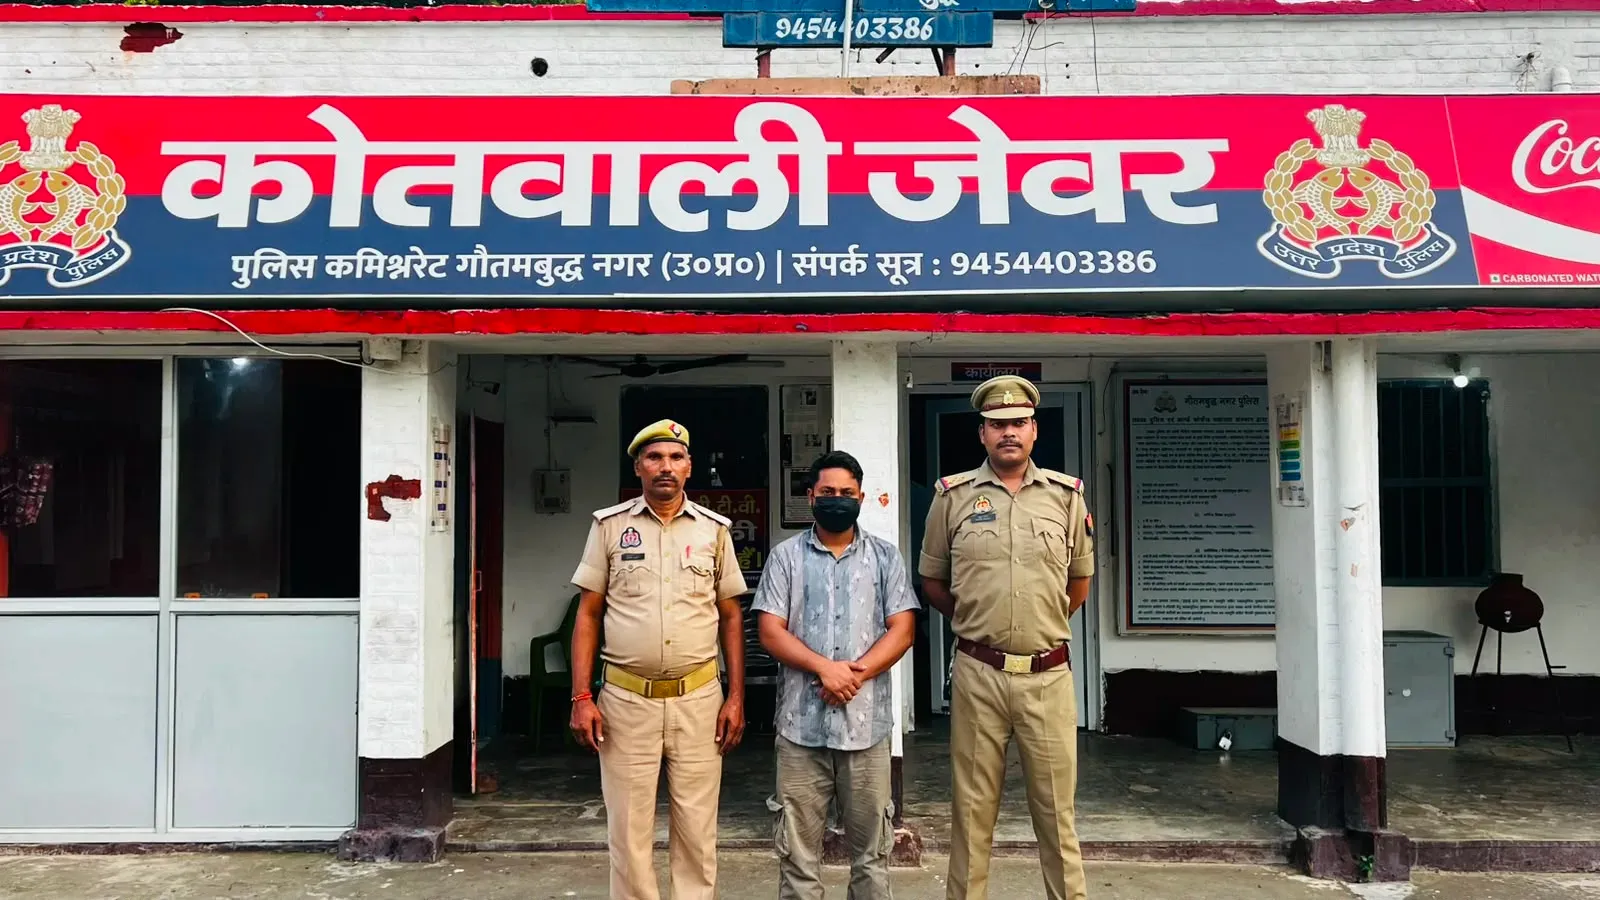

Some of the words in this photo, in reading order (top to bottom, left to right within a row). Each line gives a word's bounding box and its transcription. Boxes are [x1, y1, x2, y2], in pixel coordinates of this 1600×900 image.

[161, 102, 842, 232] कोतवाली
[854, 105, 1230, 225] जेवर
[1511, 119, 1600, 194] Coc
[2, 245, 60, 265] प्रदेश
[65, 248, 120, 281] पुलिस
[231, 248, 319, 289] पुलिस
[324, 246, 450, 280] कमिश्नरेट
[455, 244, 586, 287] गौतमबुद्ध
[591, 253, 654, 278] नगर
[791, 245, 869, 277] संपर्क
[875, 252, 924, 286] सूत्र
[950, 249, 1157, 276] 9454403386
[1273, 242, 1321, 271] उत्तर
[1327, 238, 1385, 257] प्रदेश
[1395, 240, 1445, 272] पुलिस
[1502, 273, 1574, 283] CARBONATED
[964, 363, 1025, 379] कार्यालय
